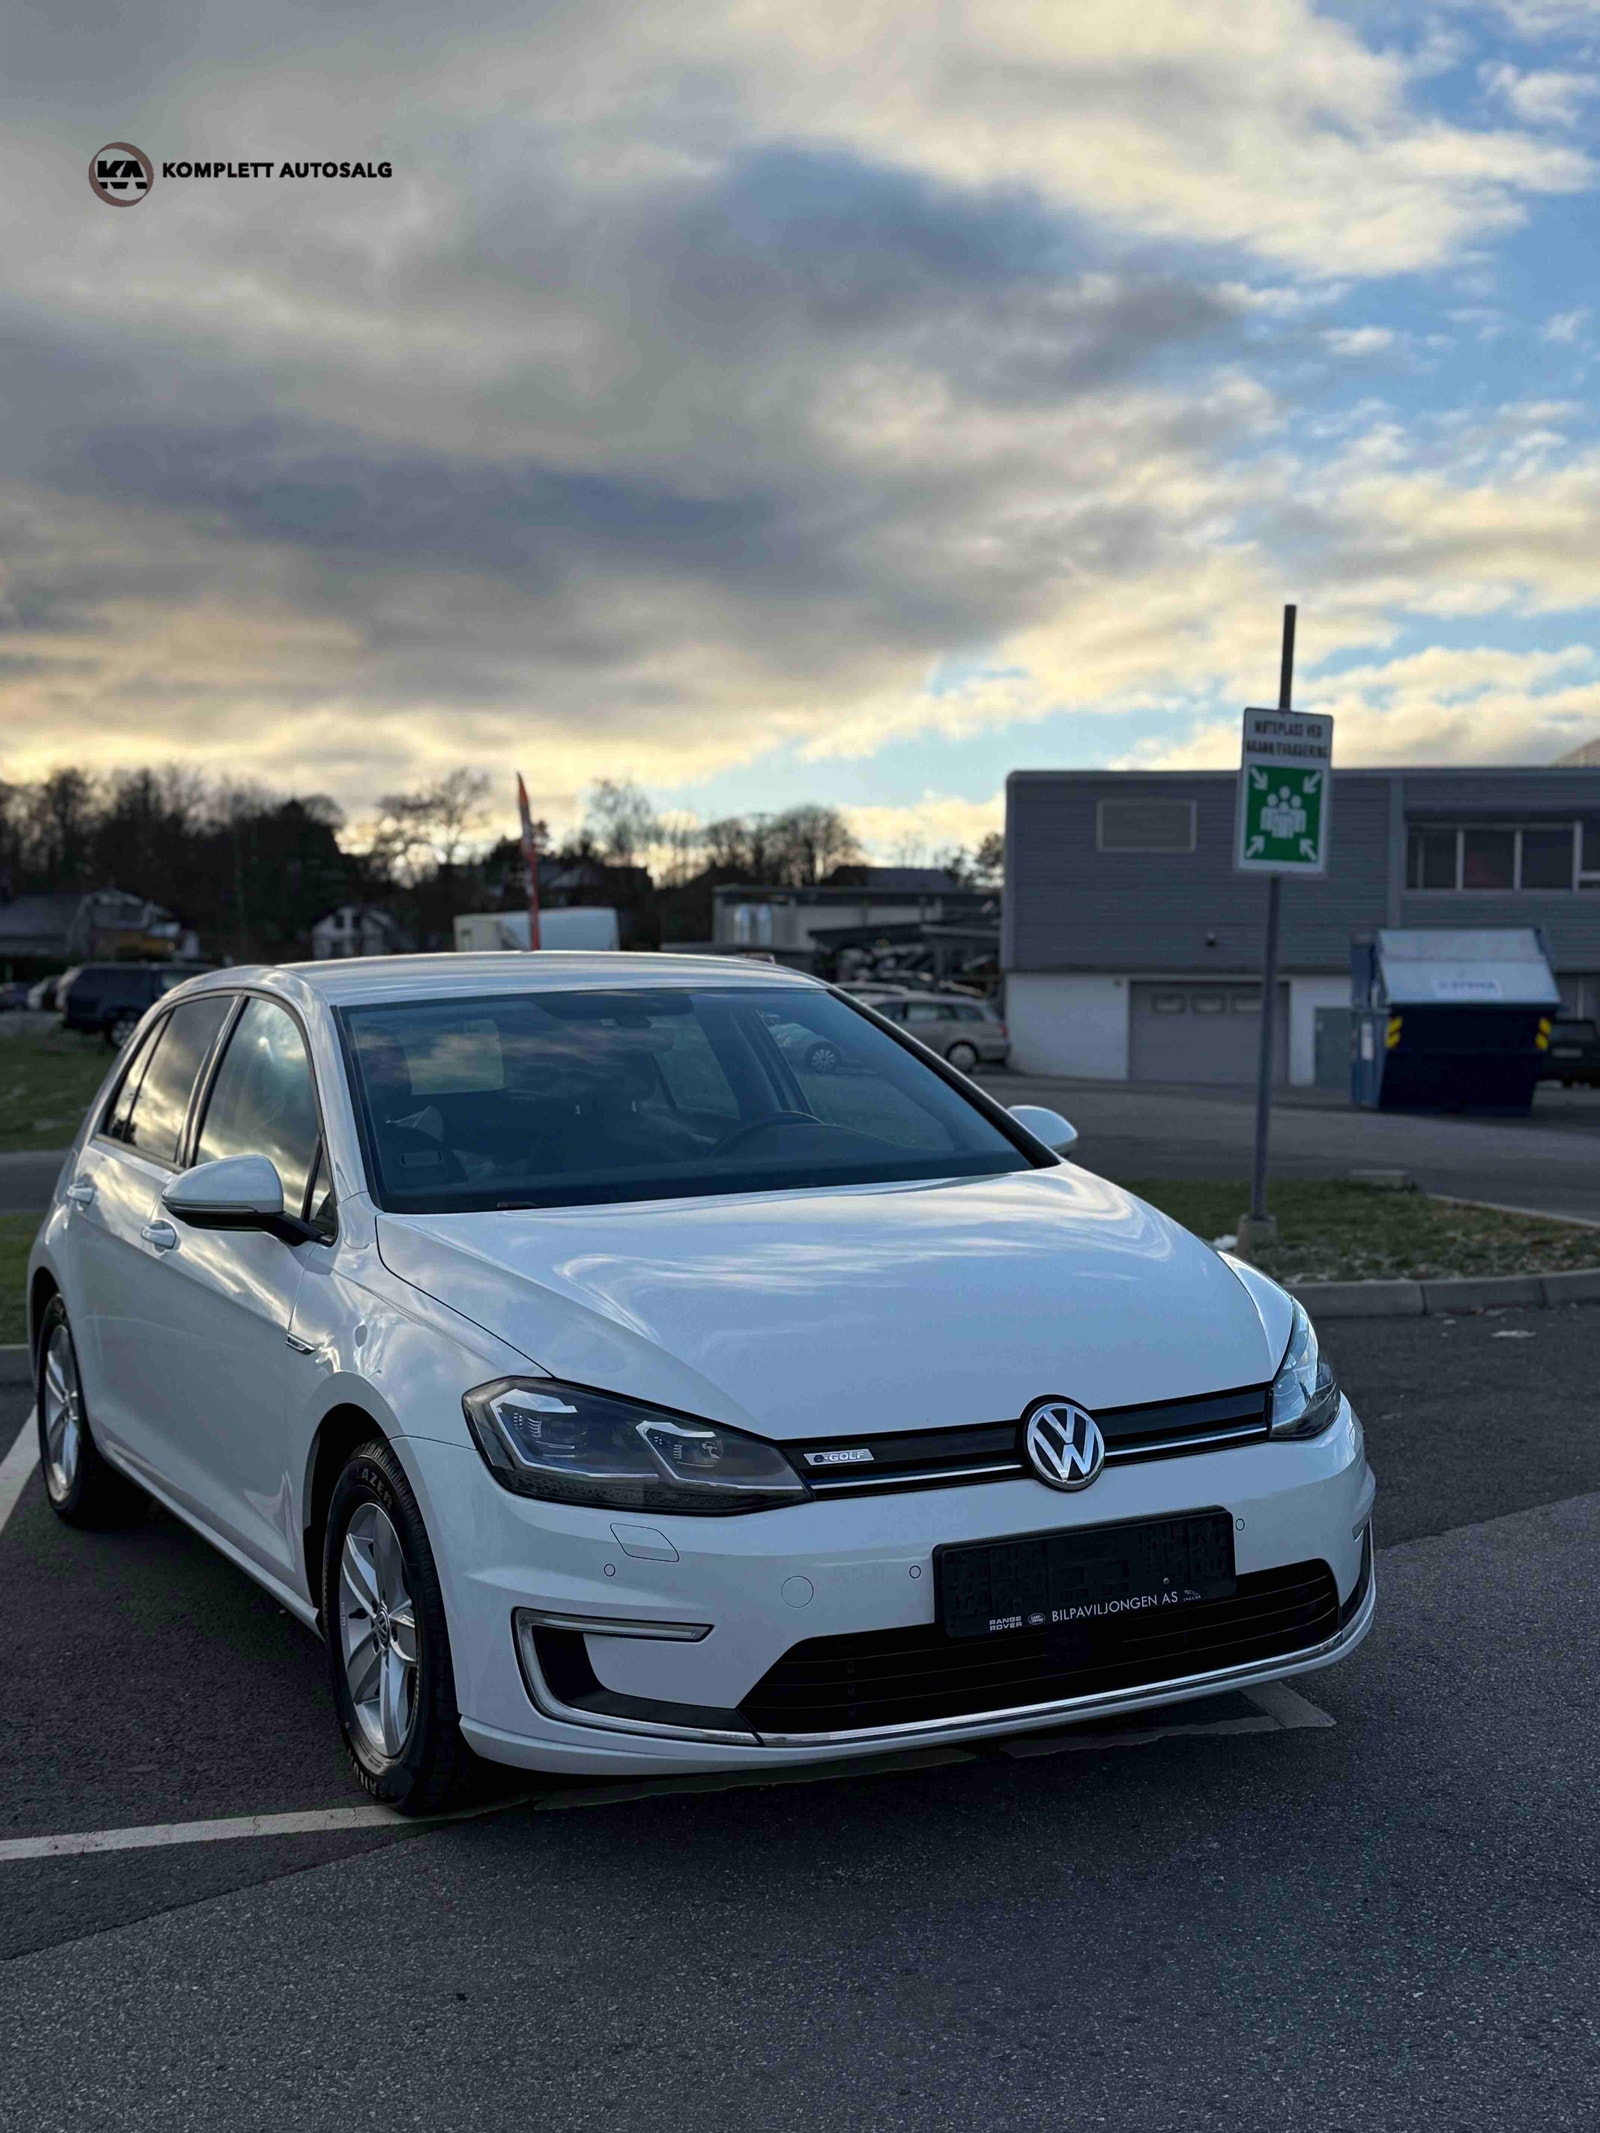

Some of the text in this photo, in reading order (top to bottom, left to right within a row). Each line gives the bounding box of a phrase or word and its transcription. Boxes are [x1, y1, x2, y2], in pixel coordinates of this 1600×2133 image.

[350, 1466, 394, 1511] LAZER
[1052, 1591, 1178, 1623] BILPAVILJONGEN AS
[989, 1616, 1022, 1626] RANGE
[989, 1621, 1023, 1632] ROVER
